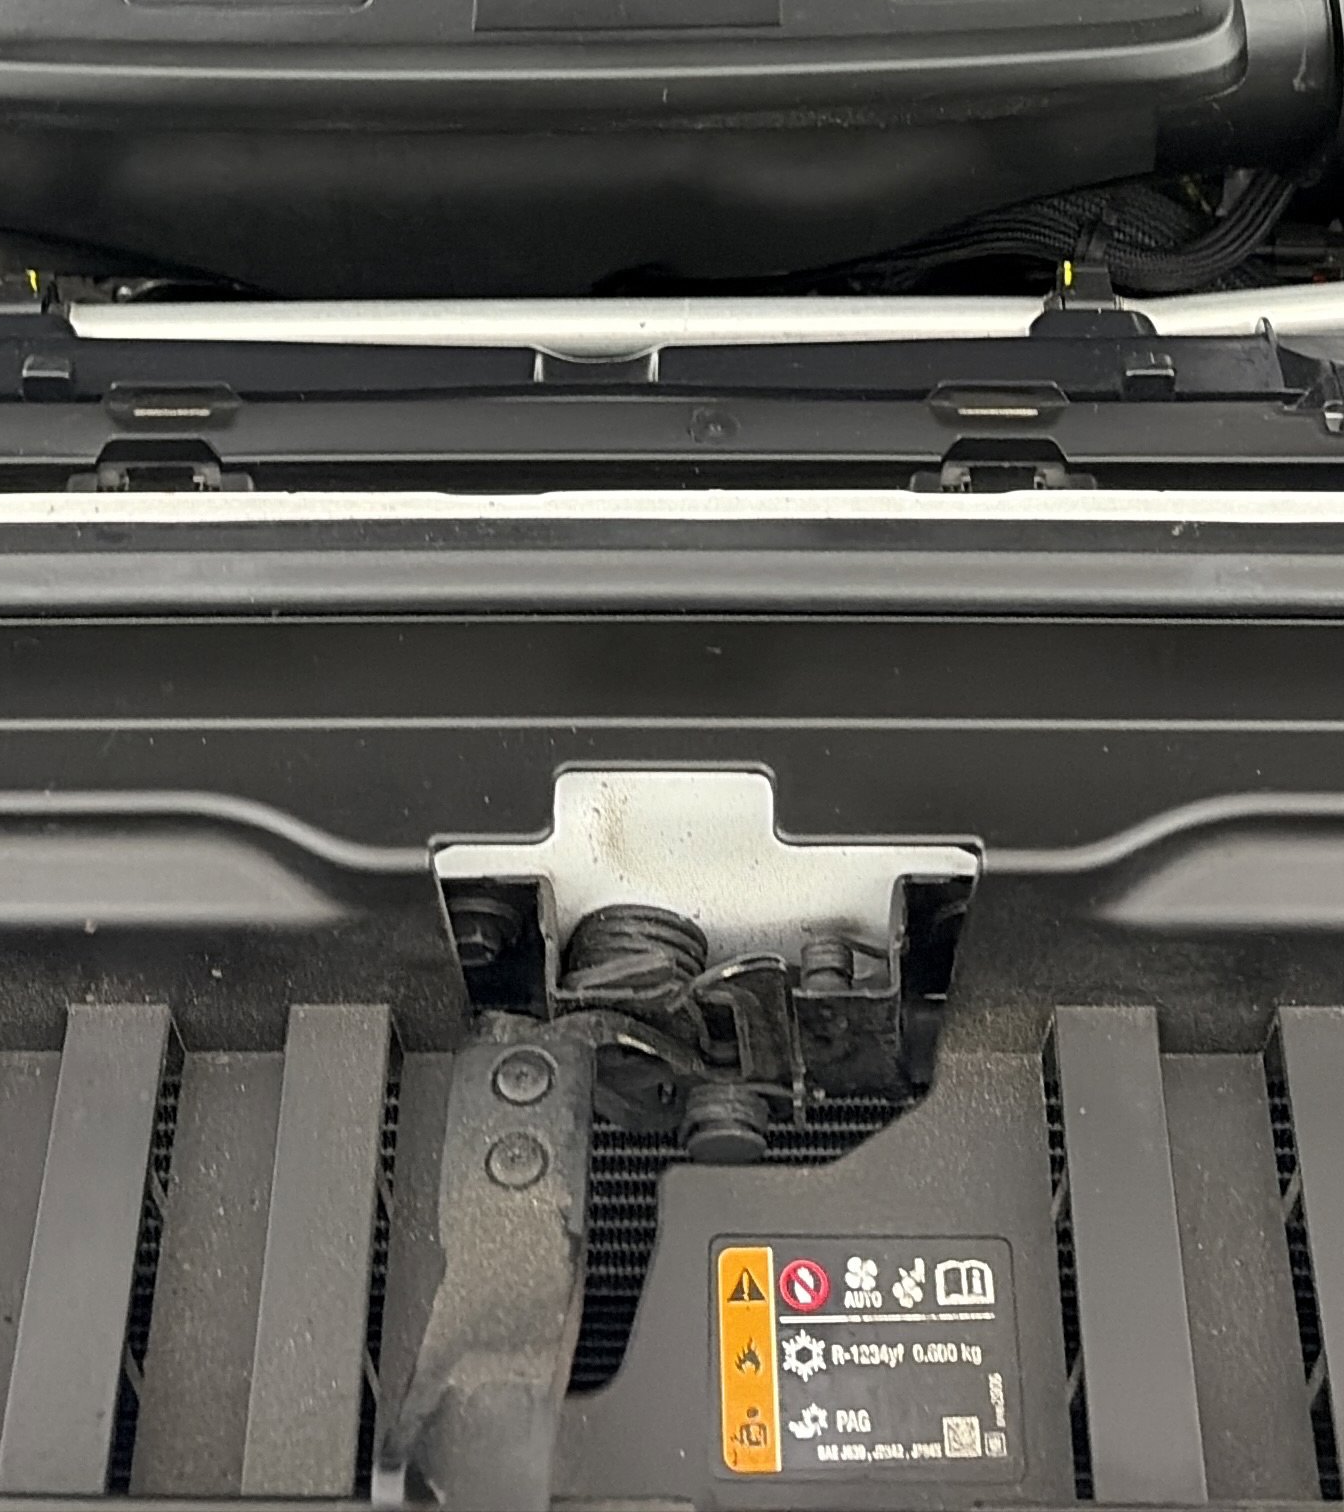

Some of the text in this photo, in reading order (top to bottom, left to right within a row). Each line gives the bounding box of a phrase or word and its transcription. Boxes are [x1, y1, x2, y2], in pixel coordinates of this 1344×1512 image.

[843, 1290, 883, 1309] AUTO
[830, 1342, 906, 1369] R-1234yf
[960, 1341, 983, 1366] kg
[835, 1408, 872, 1433] PAG
